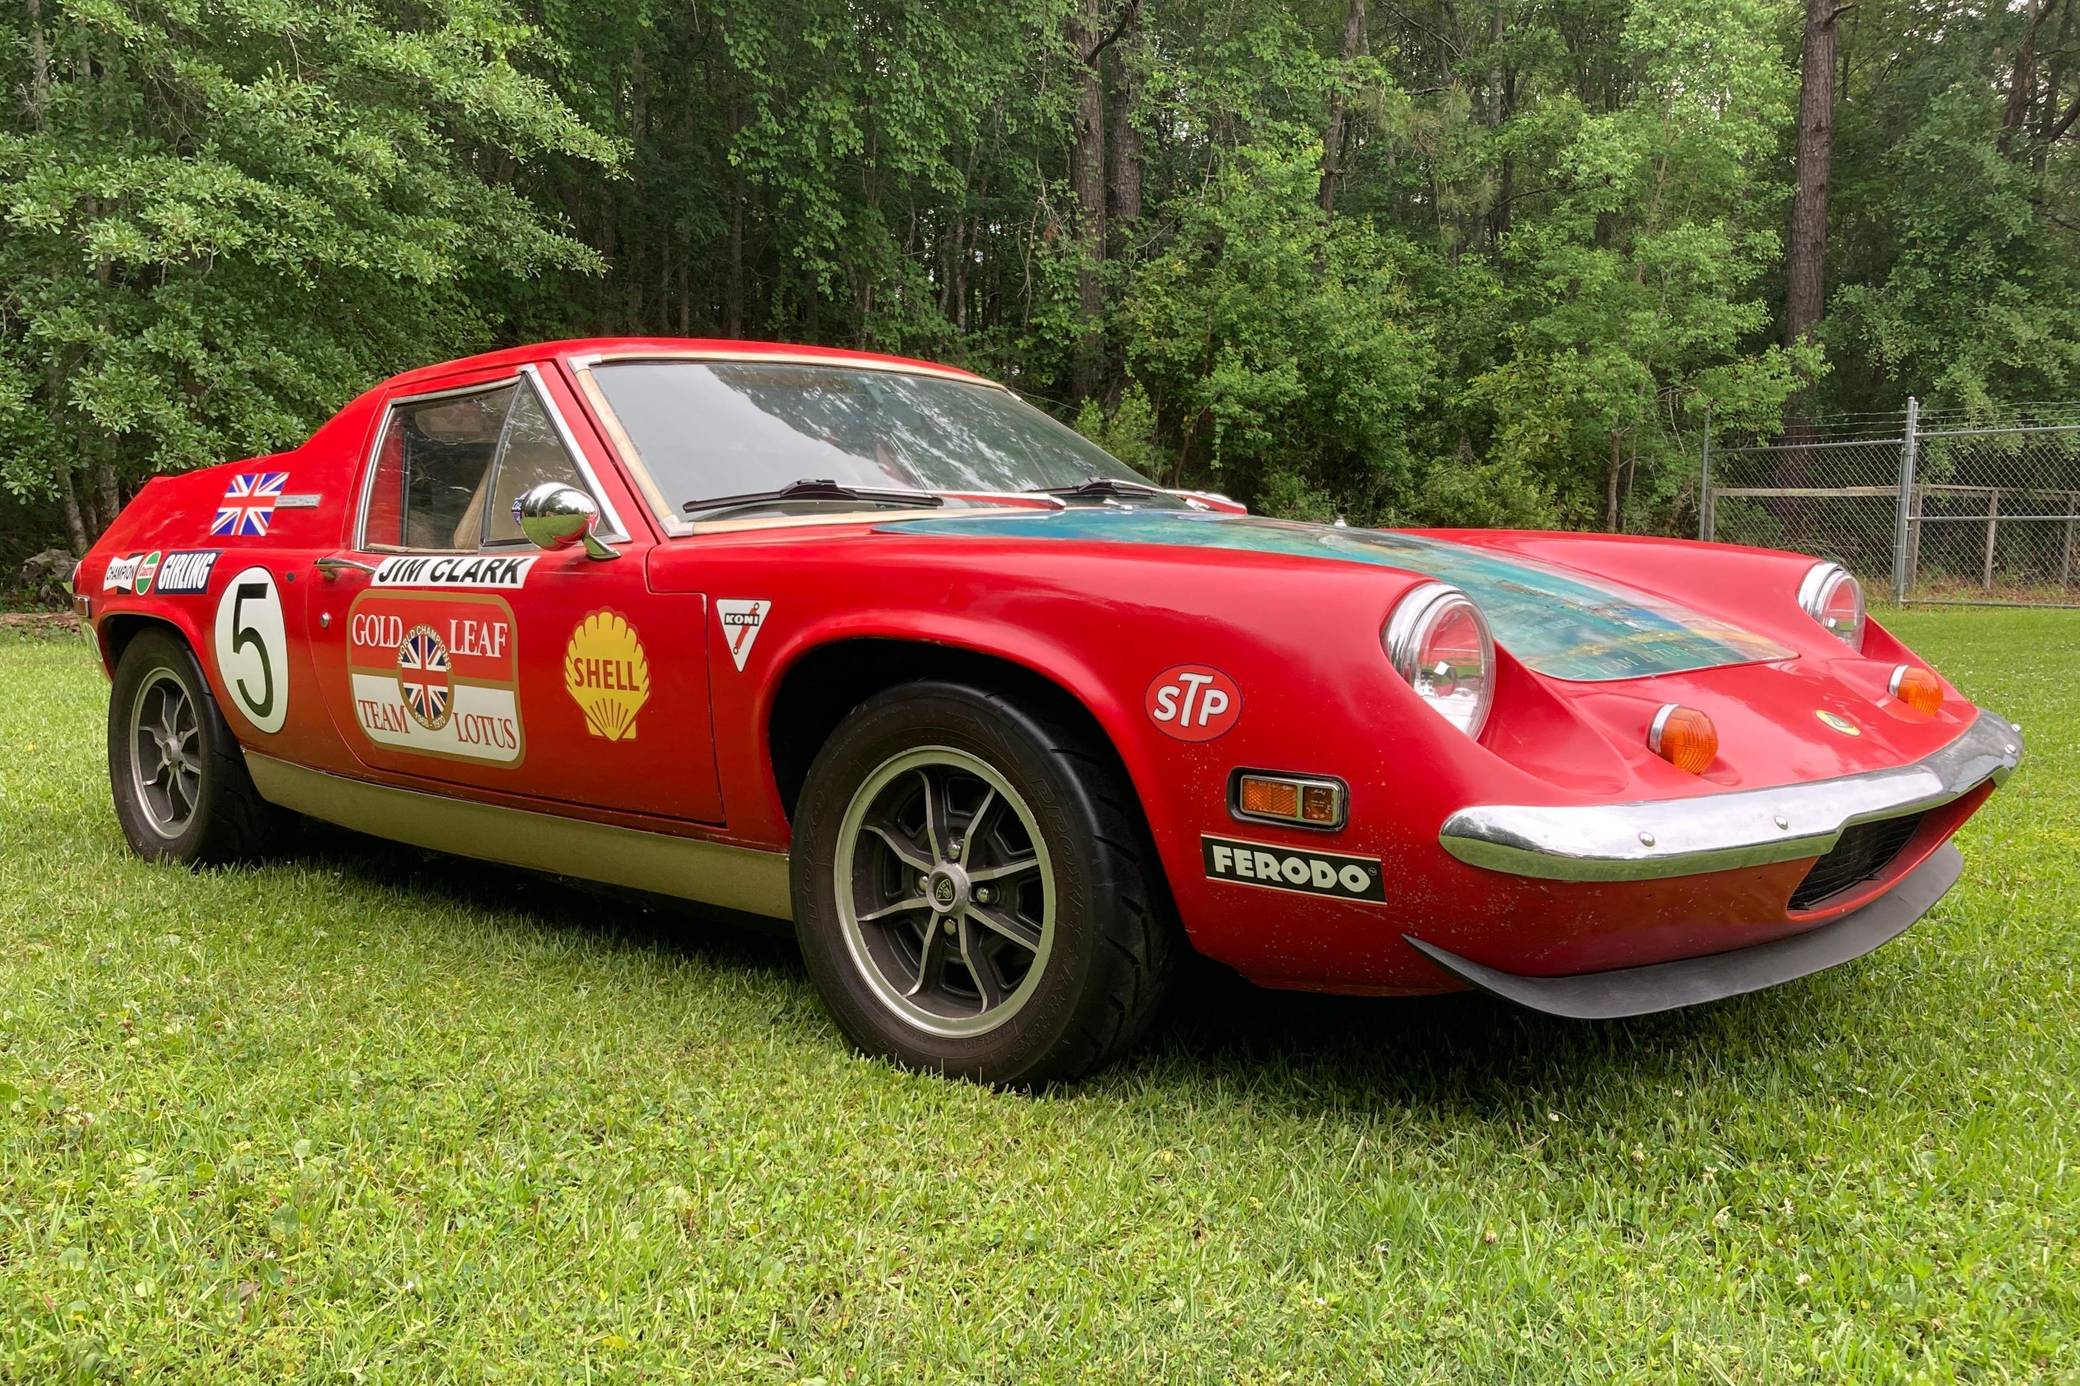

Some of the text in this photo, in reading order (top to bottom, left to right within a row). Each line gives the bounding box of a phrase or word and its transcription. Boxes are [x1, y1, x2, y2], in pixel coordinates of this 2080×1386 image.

[106, 564, 138, 581] CHAMPION
[158, 552, 217, 590] GIRLING
[378, 558, 533, 584] JIM CLARK
[352, 613, 508, 658] GOLD LEAF
[725, 613, 760, 626] KONI
[233, 583, 273, 718] 5
[397, 624, 453, 672] WORLD CHAMPIONS
[573, 657, 640, 692] SHELL
[1153, 672, 1230, 727] STP
[358, 699, 517, 750] TEAM LOTUS
[1212, 844, 1371, 893] FERODO
